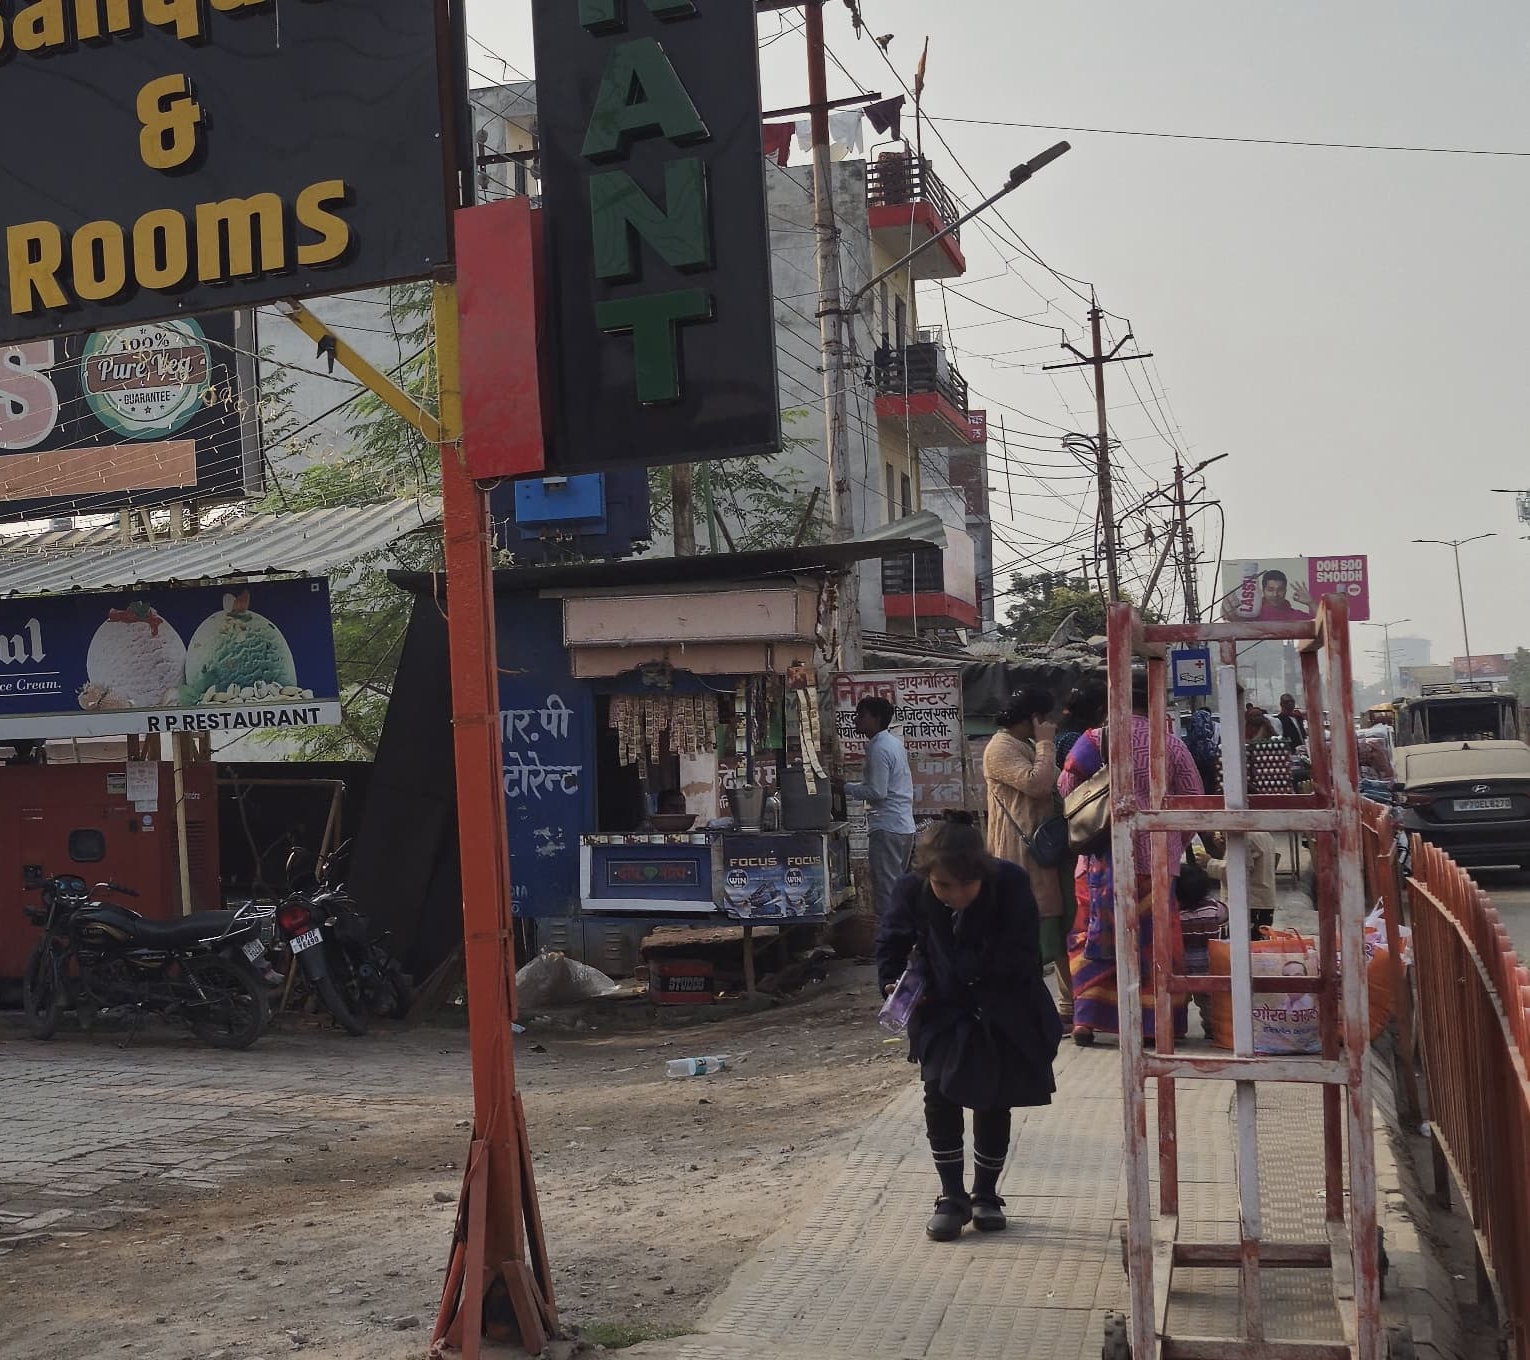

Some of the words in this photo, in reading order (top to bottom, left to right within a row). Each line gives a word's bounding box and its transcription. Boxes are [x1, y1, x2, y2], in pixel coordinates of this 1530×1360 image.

[136, 74, 202, 170] &
[6, 180, 351, 316] Rooms
[120, 332, 170, 352] 100%
[97, 357, 148, 382] Pure
[150, 351, 193, 383] Veg
[124, 390, 172, 405] GUARANTEE
[16, 678, 62, 691] Cream.
[147, 716, 160, 732] R
[182, 708, 321, 731] RESTAURANT
[730, 857, 778, 867] FOCUS
[729, 877, 747, 885] WIN
